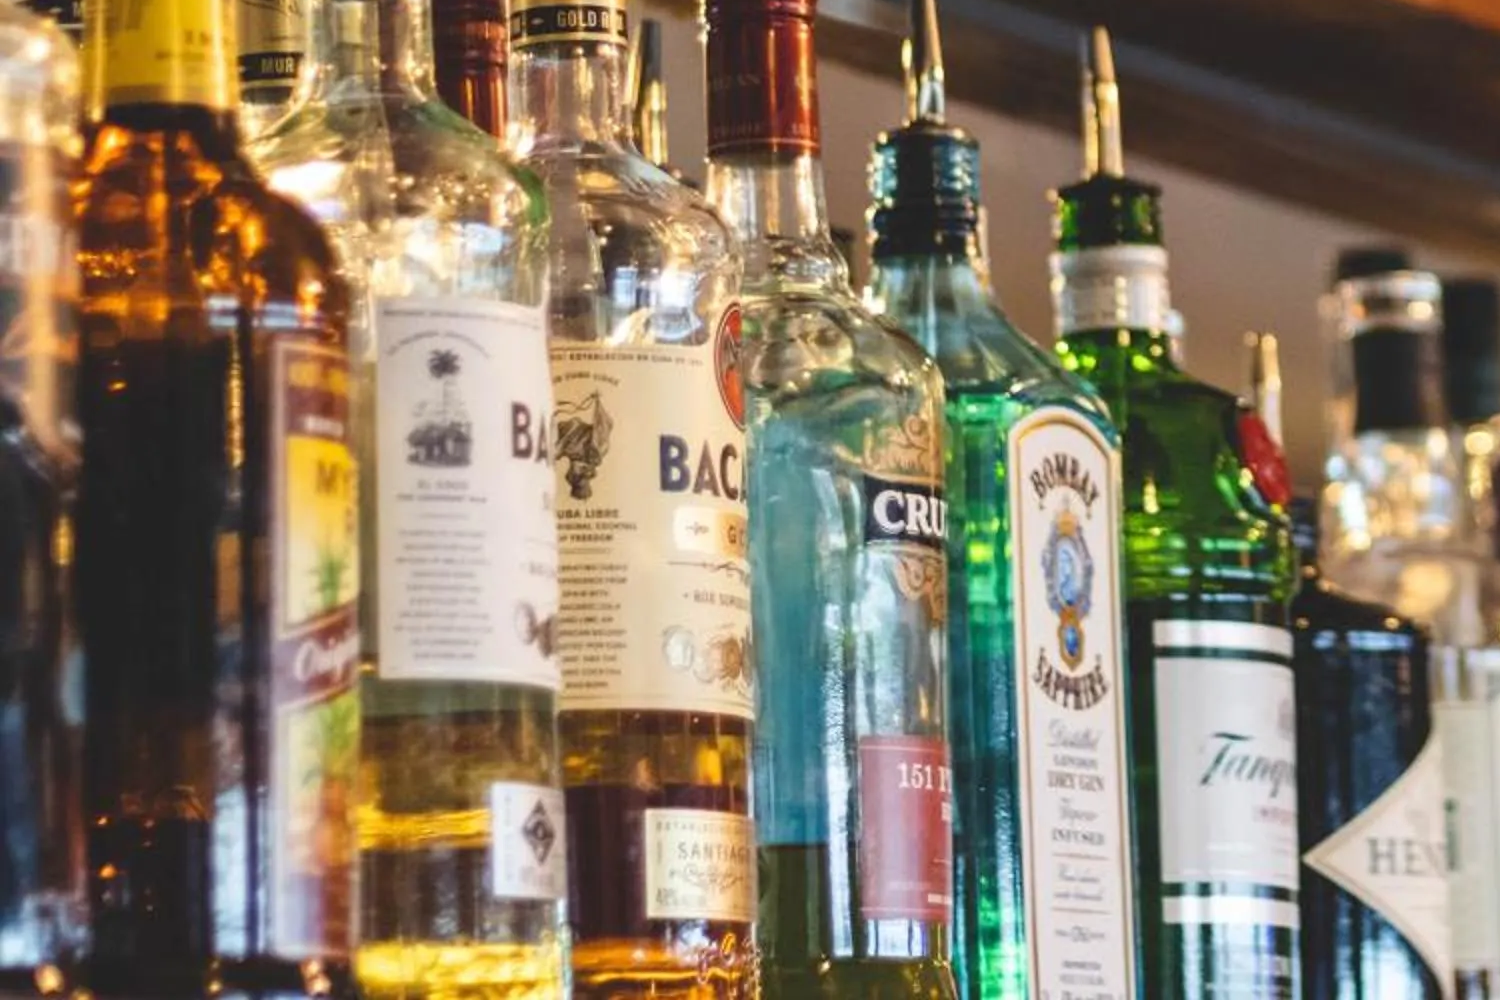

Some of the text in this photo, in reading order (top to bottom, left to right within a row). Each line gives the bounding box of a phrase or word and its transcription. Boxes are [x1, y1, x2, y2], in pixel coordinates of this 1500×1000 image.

[556, 7, 597, 28] GOLD
[1028, 452, 1099, 507] BOMBAY
[585, 508, 619, 519] LIBRE
[569, 533, 613, 542] FREEDOM
[1032, 653, 1110, 712] SAPPHIRE
[896, 762, 934, 791] 151
[1046, 769, 1076, 790] DRY
